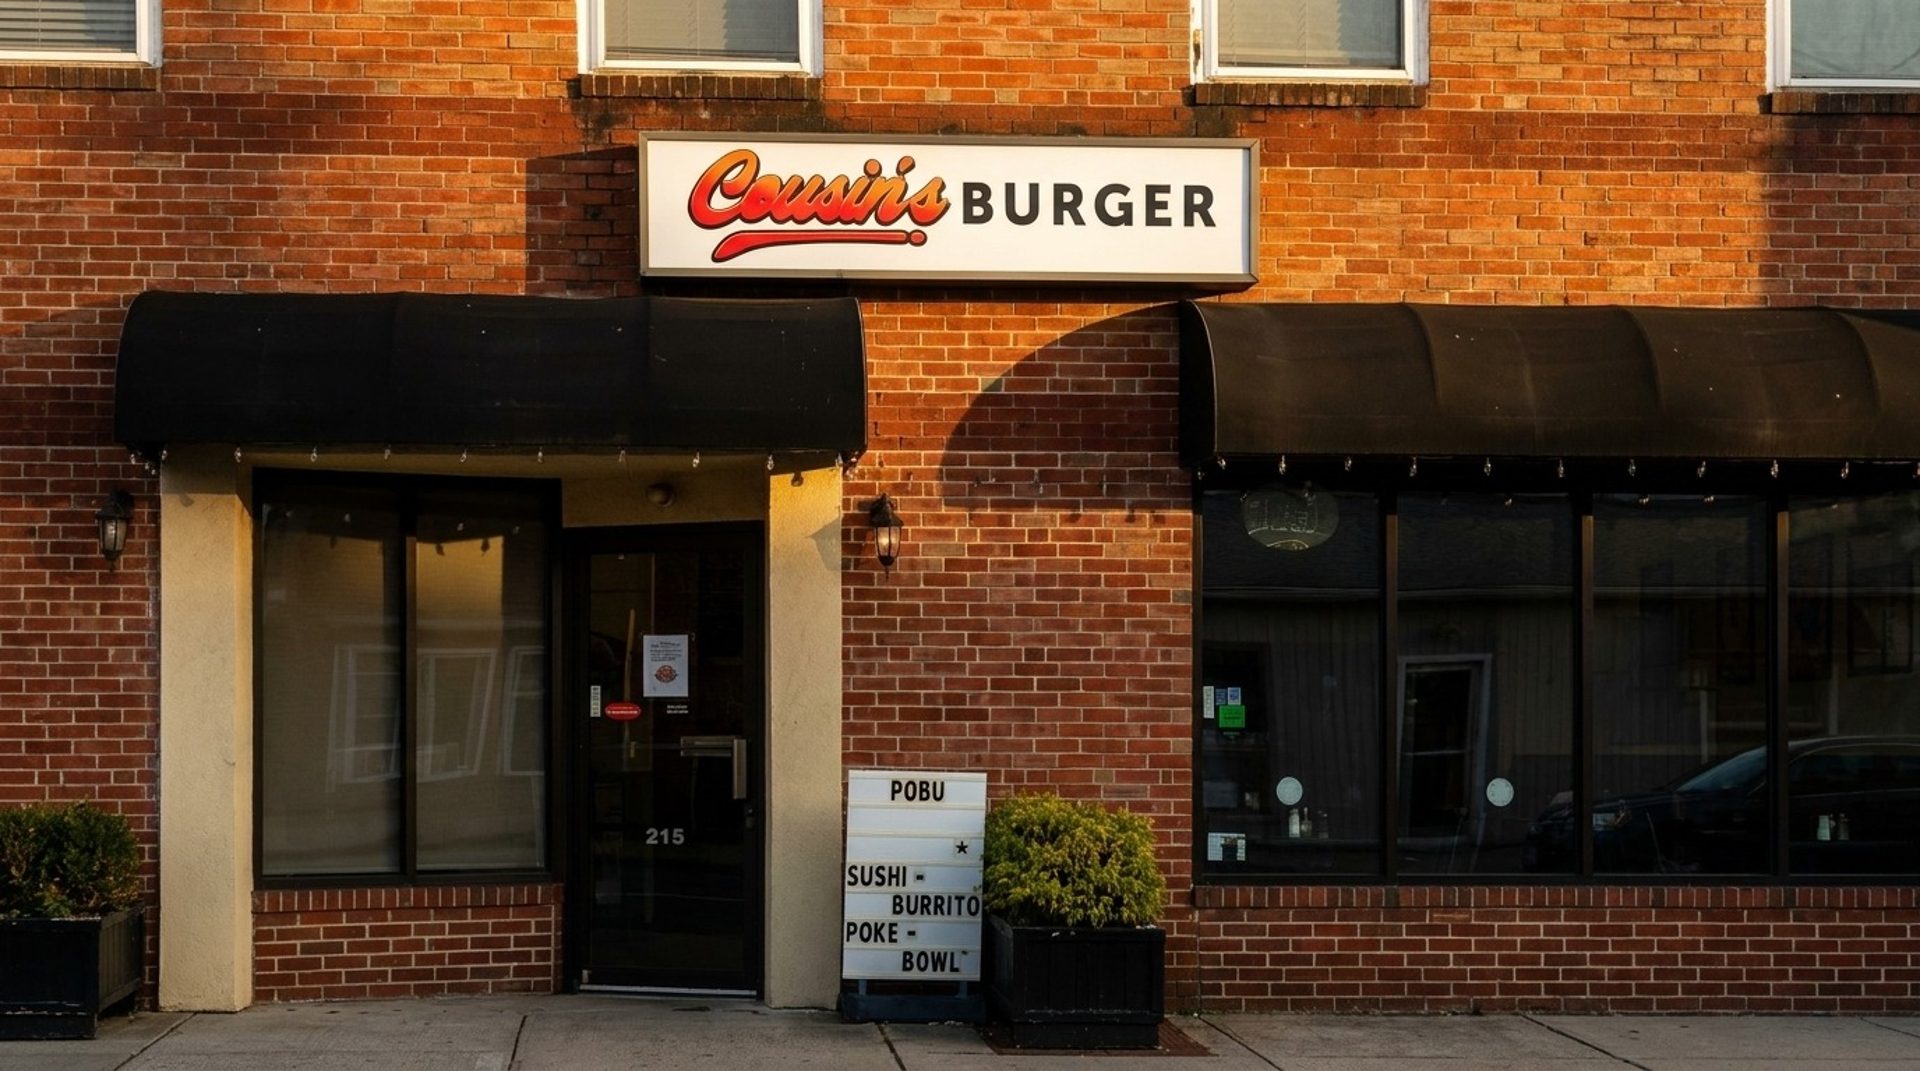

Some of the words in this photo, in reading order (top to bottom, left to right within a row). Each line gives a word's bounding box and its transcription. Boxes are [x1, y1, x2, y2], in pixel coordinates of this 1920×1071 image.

[688, 149, 951, 230] Cousin's
[962, 182, 1216, 227] BURGER
[891, 780, 944, 801] POBU
[646, 828, 684, 845] 215
[847, 865, 906, 887] SUSHI
[892, 894, 980, 916] BURRITO
[846, 922, 898, 943] POKE
[902, 951, 959, 972] BOWL
